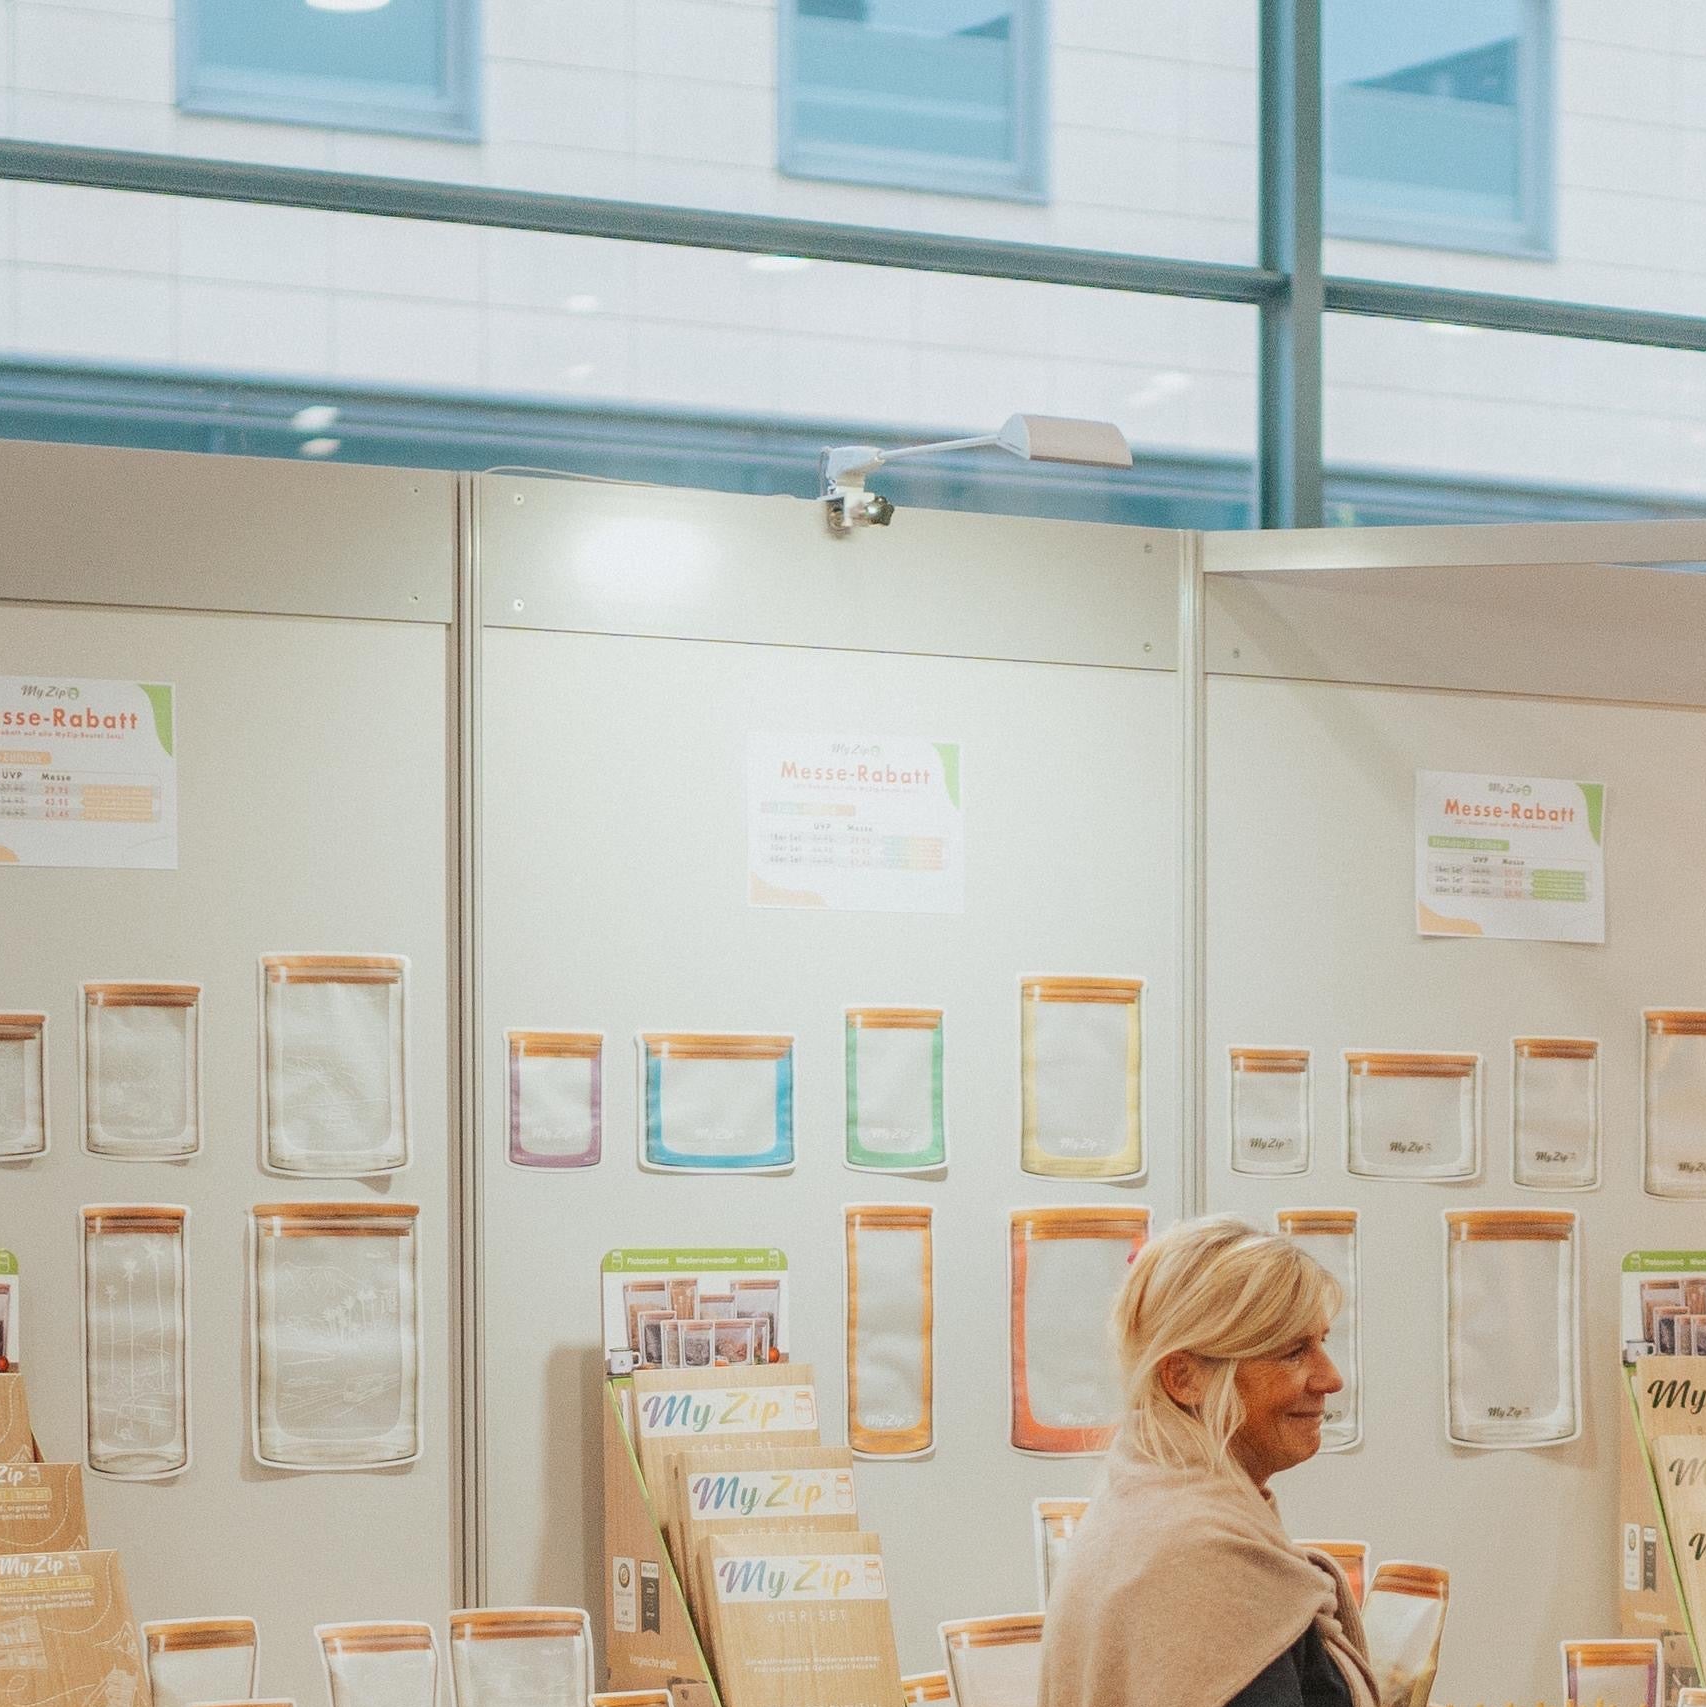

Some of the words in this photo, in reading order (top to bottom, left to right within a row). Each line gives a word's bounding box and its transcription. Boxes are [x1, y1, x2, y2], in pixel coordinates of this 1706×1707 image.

[1, 771, 23, 780] UVP
[42, 773, 72, 782] Messe
[781, 761, 931, 785] Messe-Rabatt
[1445, 799, 1575, 822] Messe-Rabatt
